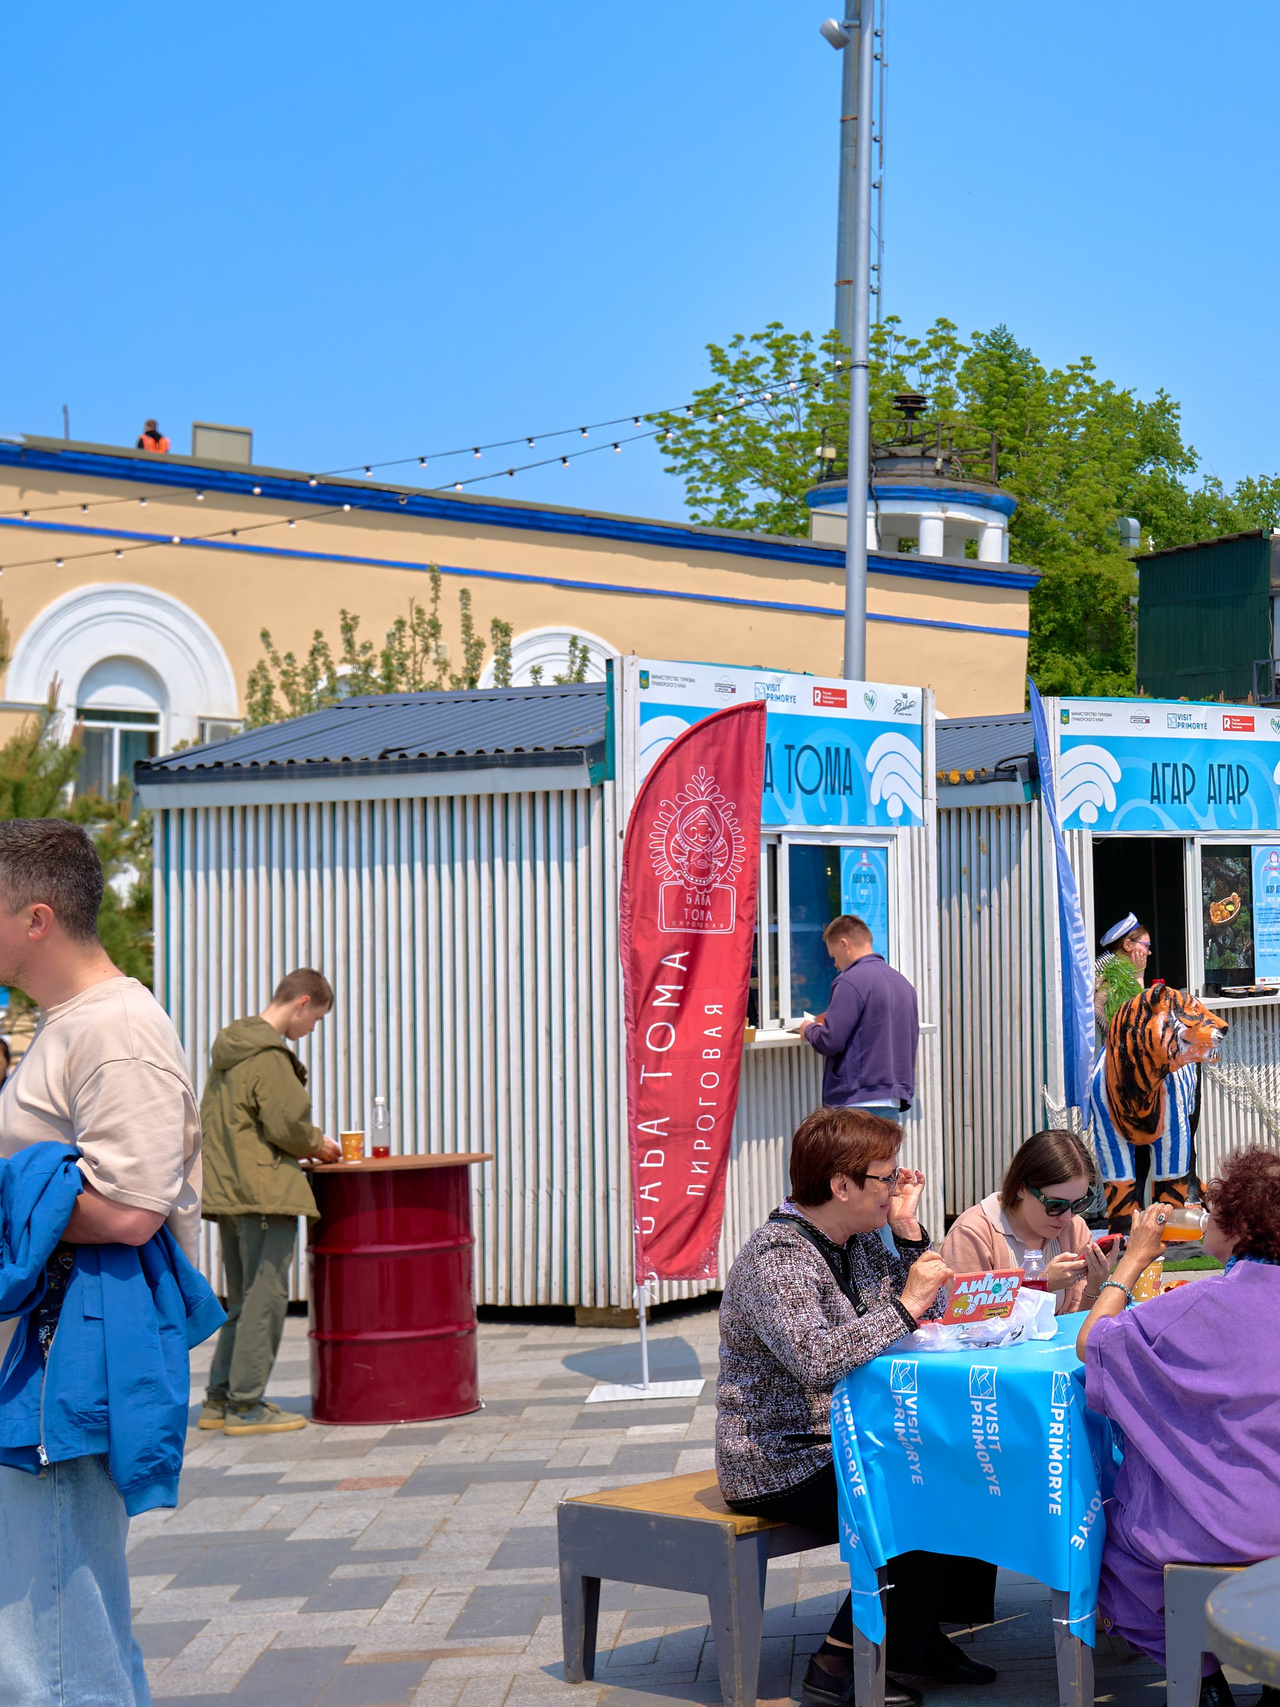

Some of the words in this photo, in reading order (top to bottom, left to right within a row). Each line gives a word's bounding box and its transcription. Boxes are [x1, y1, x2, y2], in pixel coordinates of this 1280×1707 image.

[766, 682, 781, 693] VISIT
[766, 692, 797, 704] PRIMORYE
[1177, 713, 1192, 721] VISIT
[1177, 722, 1208, 730] PRIMORYE
[785, 743, 853, 796] ТОМА
[1150, 762, 1196, 805] АГАР
[1207, 763, 1250, 805] АГАР
[683, 908, 713, 922] ТОМА
[686, 895, 711, 907] БАБА
[640, 951, 690, 1084] ТОМА
[686, 1004, 723, 1196] ПИРОГОВАЯ
[892, 1394, 924, 1486] PRIMORYE
[904, 1396, 923, 1446] VISIT
[984, 1402, 1002, 1453] VISIT
[831, 1398, 867, 1499] PRIMORYE
[970, 1400, 1001, 1497] PRIMORYE
[1048, 1408, 1064, 1517] PRIMORYE
